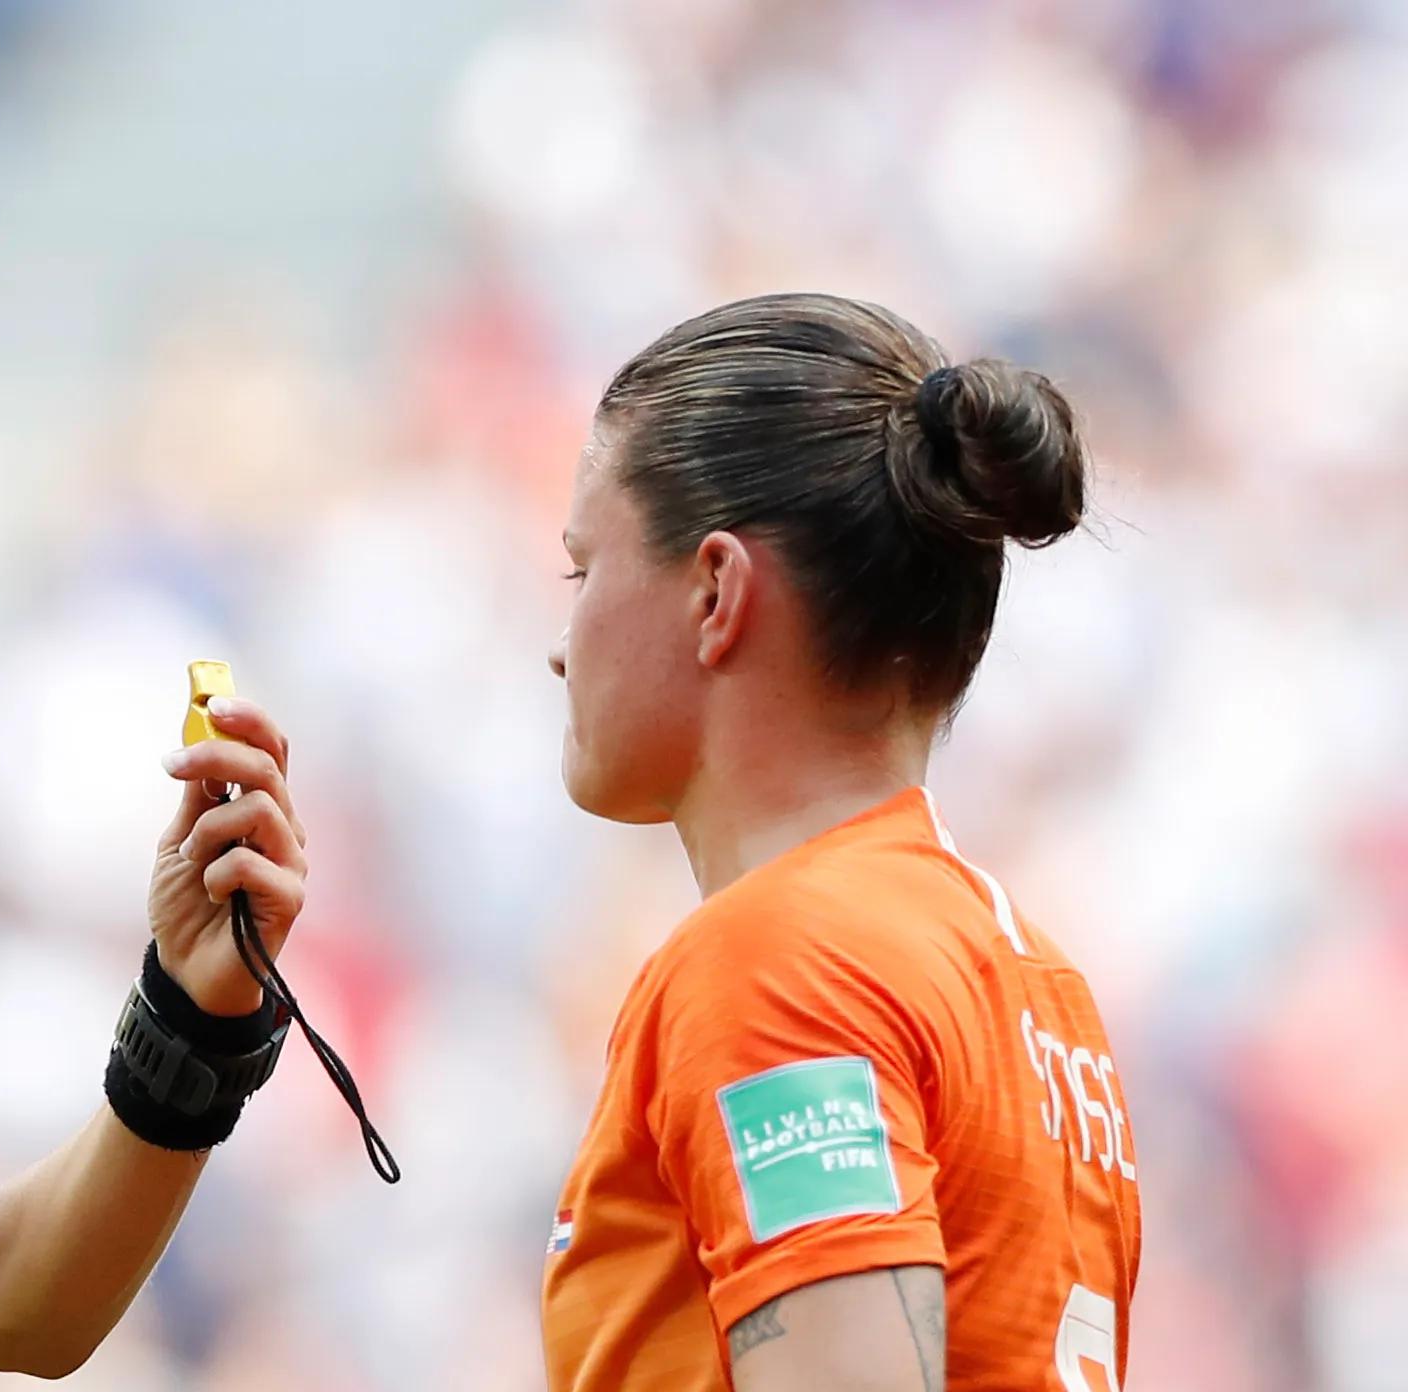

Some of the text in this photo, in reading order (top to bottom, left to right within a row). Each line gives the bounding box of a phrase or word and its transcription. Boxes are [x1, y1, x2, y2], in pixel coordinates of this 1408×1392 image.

[743, 1100, 867, 1145] LIVING
[746, 1116, 871, 1161] FOOTBALL
[820, 1148, 878, 1172] FIFA
